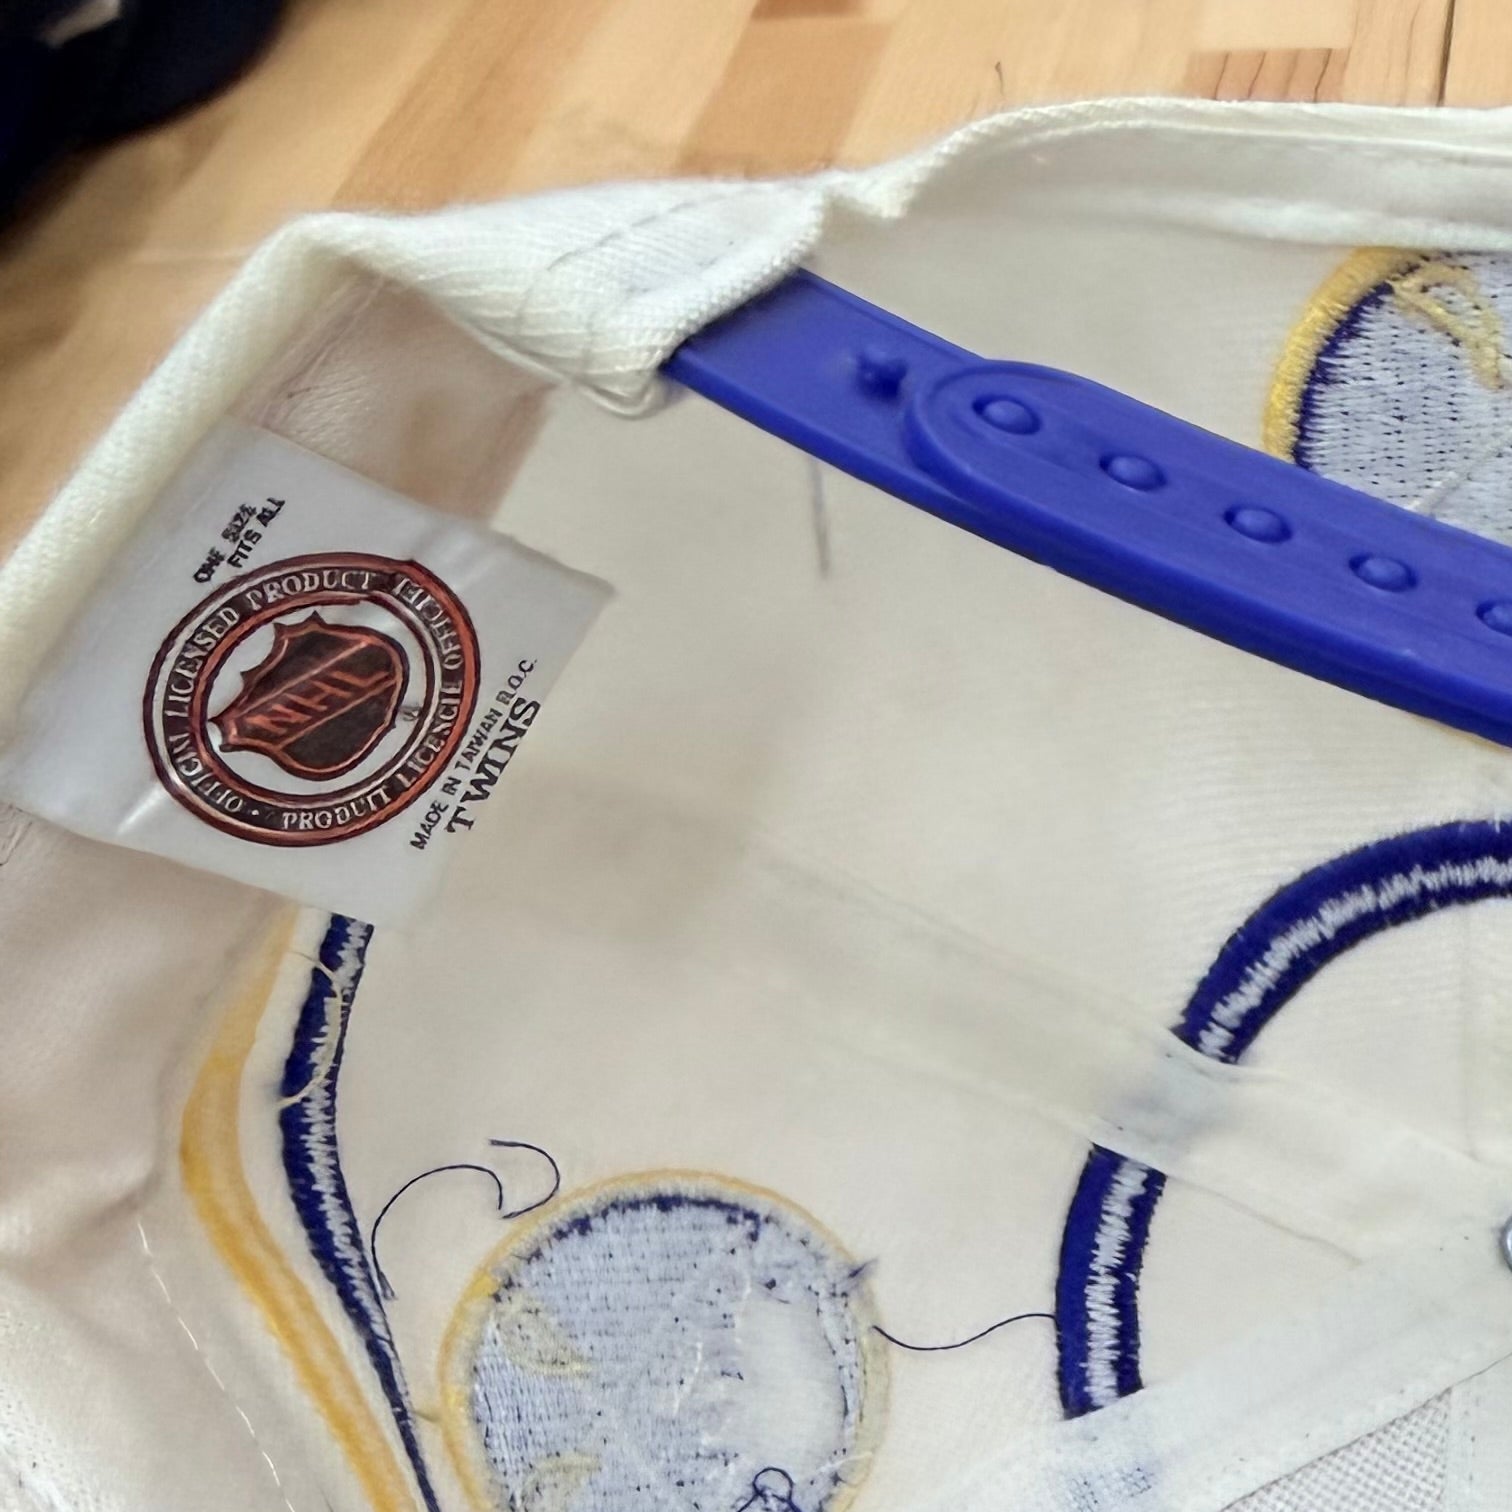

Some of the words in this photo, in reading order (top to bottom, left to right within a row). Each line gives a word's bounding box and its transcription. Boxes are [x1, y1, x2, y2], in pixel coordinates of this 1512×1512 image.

[193, 547, 224, 583] ONE
[222, 504, 257, 542] SIZE
[228, 529, 262, 568] FITS
[257, 498, 285, 528] ALL
[166, 606, 241, 719] LICENSED
[246, 570, 374, 611] PRODUCT
[246, 670, 391, 733] NHL
[410, 800, 448, 850] MADE
[443, 777, 462, 796] IN
[455, 708, 502, 770] TAIWAN
[446, 697, 540, 833] TWINS
[283, 787, 391, 830] PRODUIT
